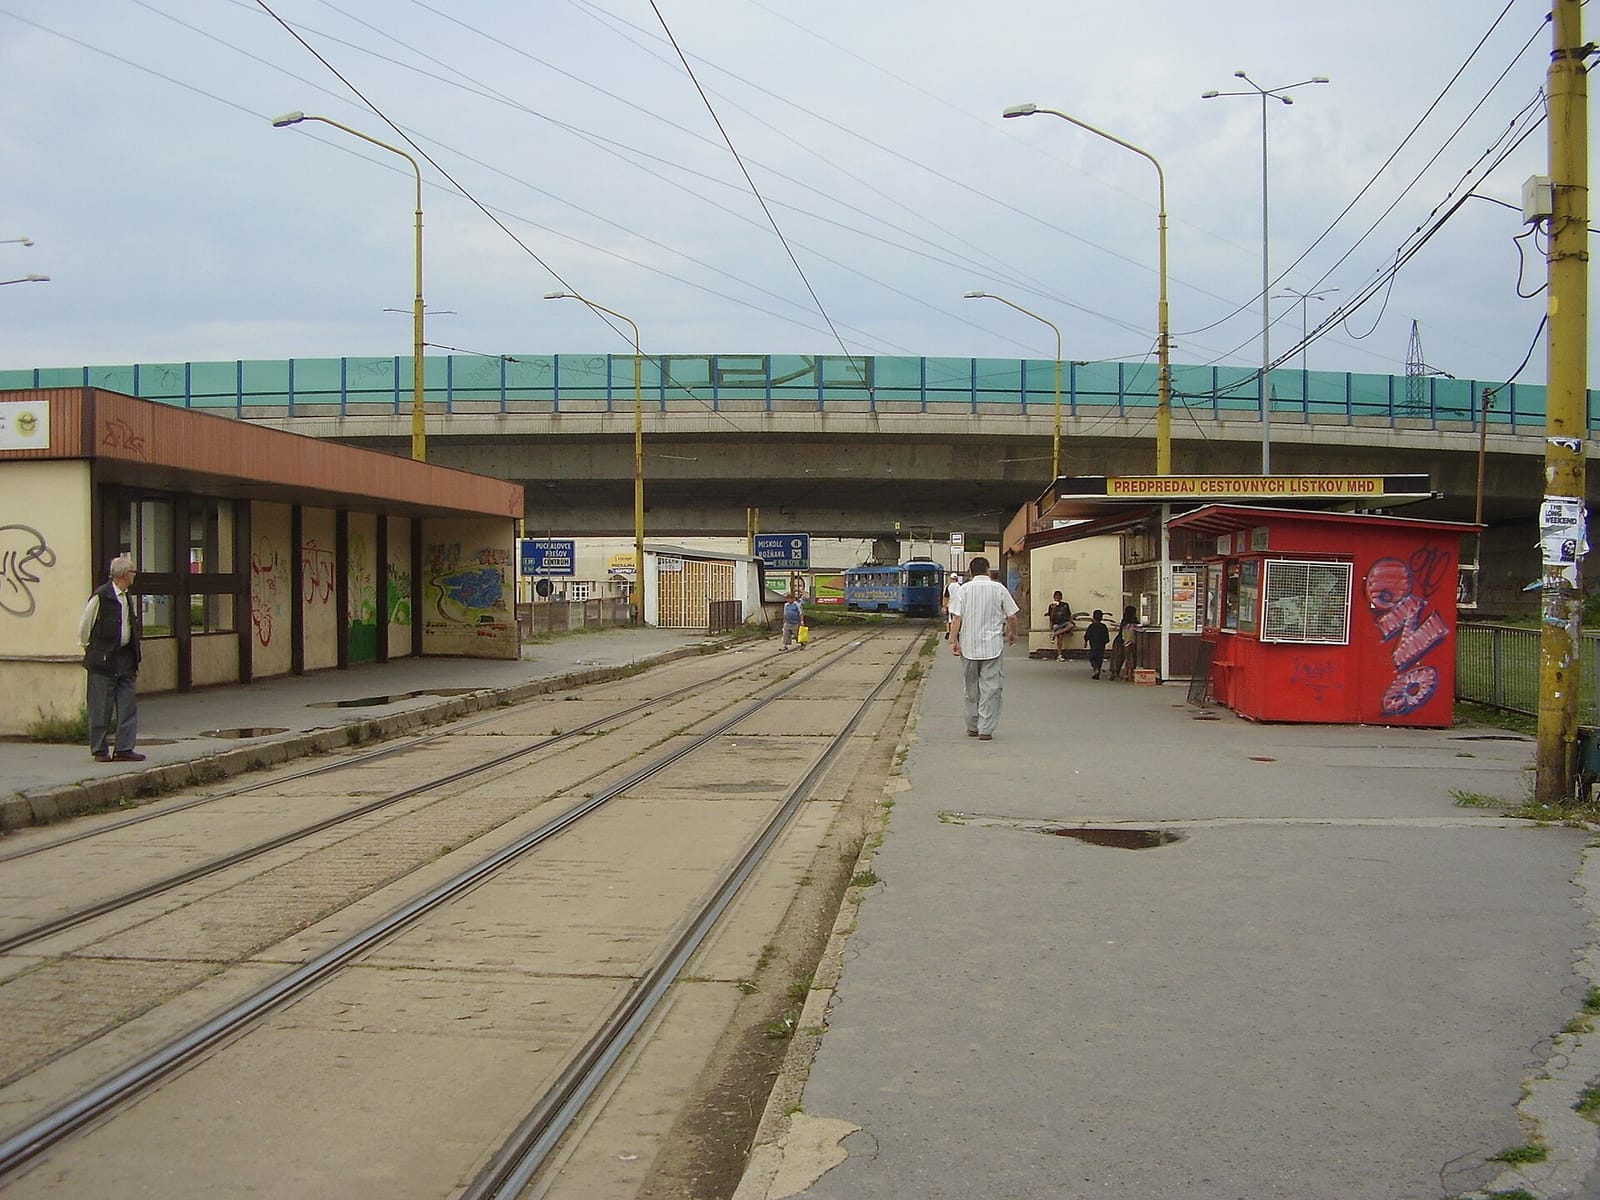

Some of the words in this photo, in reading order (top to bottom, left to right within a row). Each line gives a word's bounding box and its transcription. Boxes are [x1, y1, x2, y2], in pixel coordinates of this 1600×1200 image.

[1114, 480, 1196, 492] PREDPREDAJ
[1200, 478, 1286, 492] CESTOVNÝCH
[1347, 480, 1375, 492] MHD
[1545, 516, 1578, 525] WEEKEND
[535, 542, 571, 550] MICALOVCE
[758, 540, 783, 548] MISKOLC
